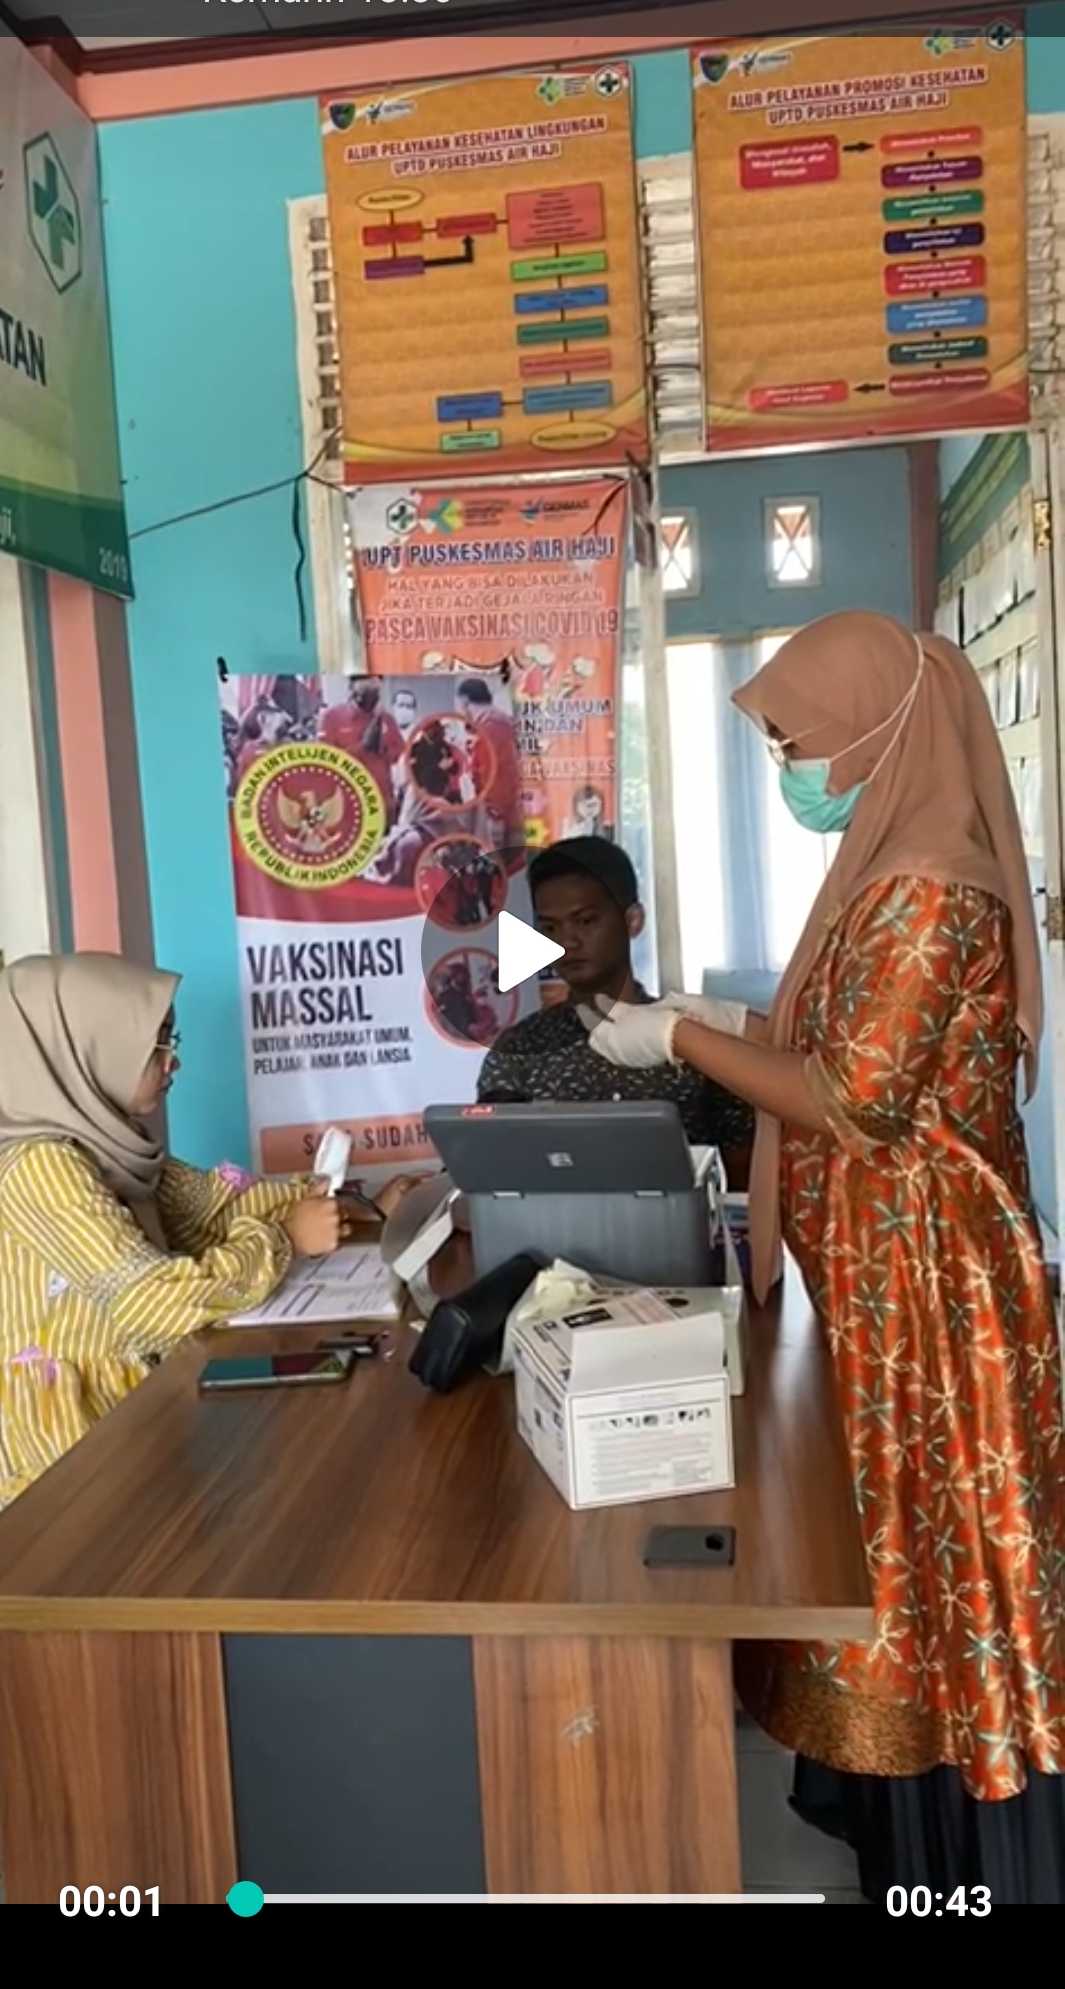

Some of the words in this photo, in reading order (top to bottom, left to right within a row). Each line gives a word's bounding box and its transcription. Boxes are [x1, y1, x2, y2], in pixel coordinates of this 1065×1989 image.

[731, 92, 762, 108] ALUR
[767, 84, 840, 103] PELAYANAN
[844, 77, 906, 94] PROMOSI
[911, 67, 985, 87] KESEHATAN
[769, 108, 803, 124] UPTD
[807, 99, 886, 118] PUSKESMAS
[891, 95, 913, 110] AIR
[916, 92, 947, 107] HAJI
[348, 144, 379, 160] ALUR
[0, 307, 47, 388] TAN
[367, 546, 402, 566] UPT
[410, 541, 526, 564] PUSKESMAS
[533, 539, 563, 560] AIR
[571, 537, 614, 558] HAJI
[483, 592, 539, 608] GEJAA
[367, 617, 425, 642] PASCA
[429, 612, 529, 639] VAKSINASI
[536, 610, 592, 635] COVID
[263, 747, 340, 771] INTELIJEN
[341, 758, 379, 817] NEGARA
[246, 937, 404, 984] VAKSINASI
[251, 985, 373, 1030] MASSAL
[252, 1036, 291, 1054] UNTUK
[344, 1051, 367, 1068] DAN
[363, 1123, 428, 1149] SUDAH
